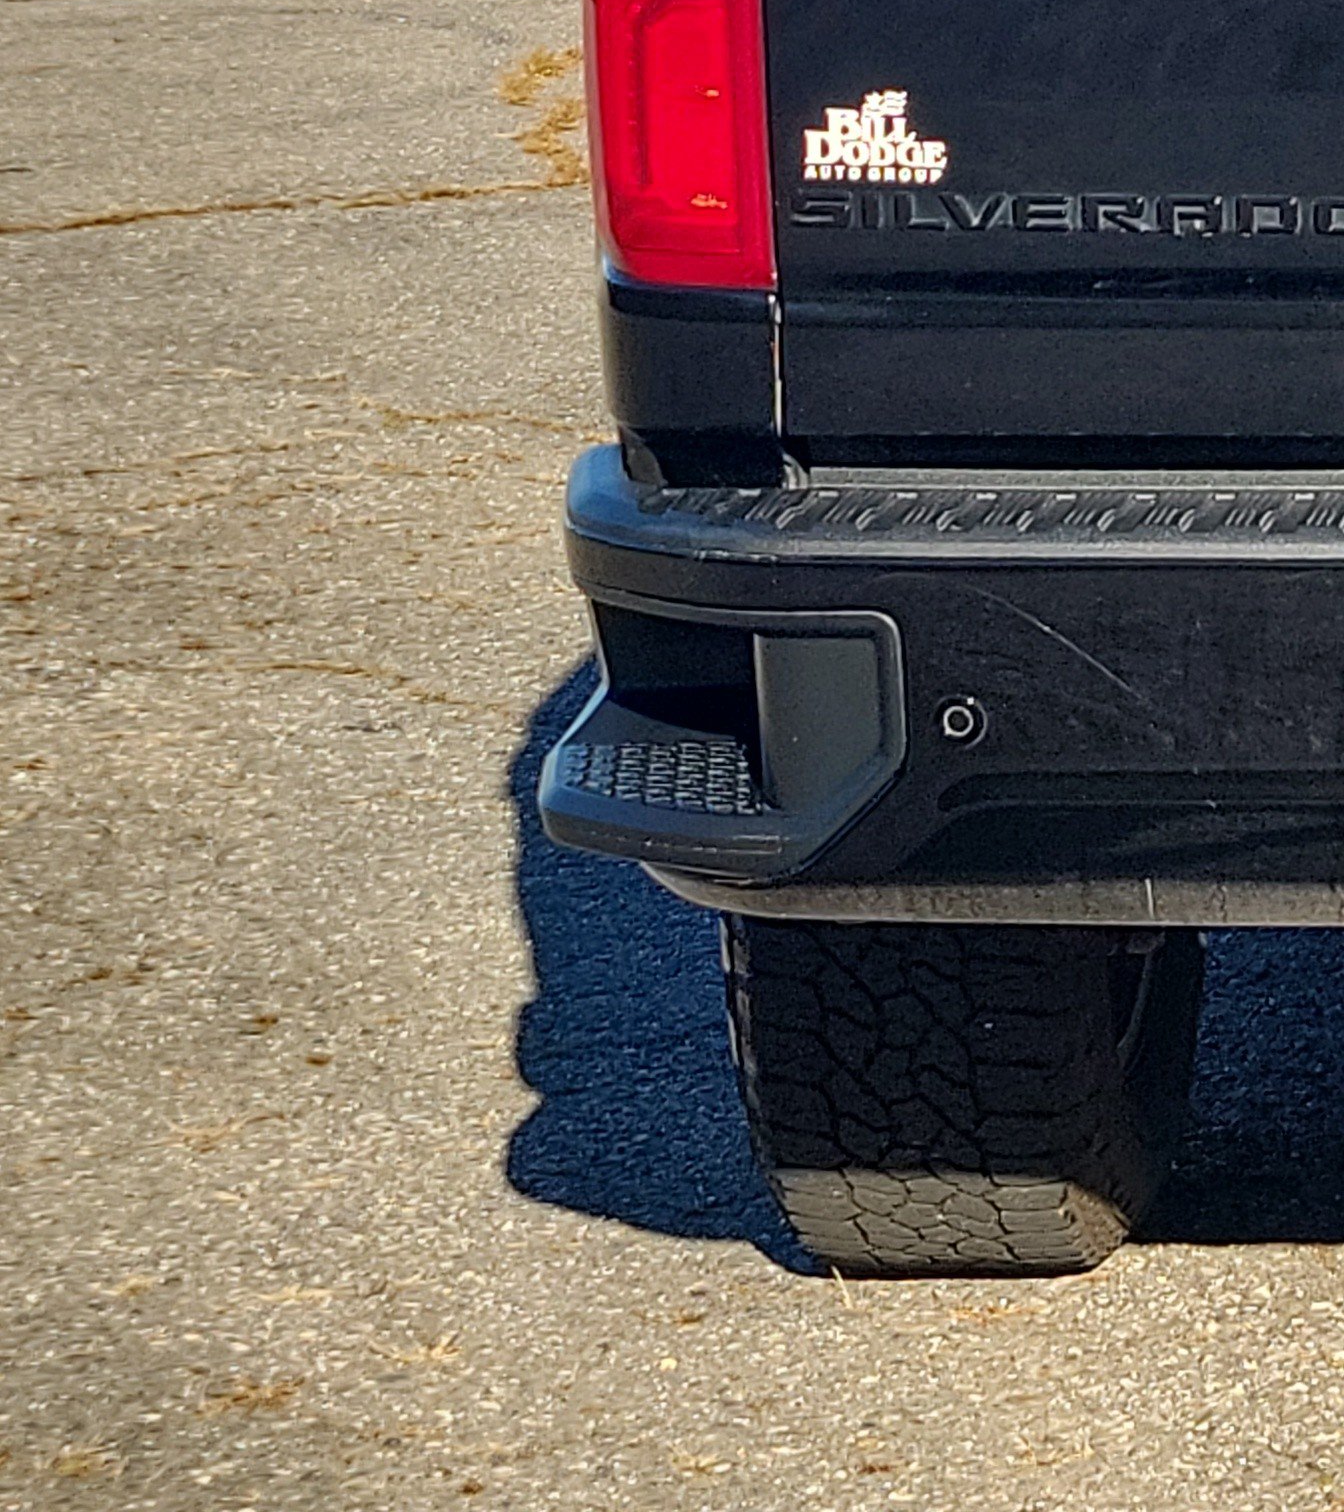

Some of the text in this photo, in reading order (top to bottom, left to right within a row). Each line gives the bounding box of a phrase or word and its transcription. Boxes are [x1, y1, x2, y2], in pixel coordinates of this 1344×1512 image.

[825, 106, 917, 143] BILL
[804, 129, 948, 169] DODGE
[804, 164, 862, 181] AUTO
